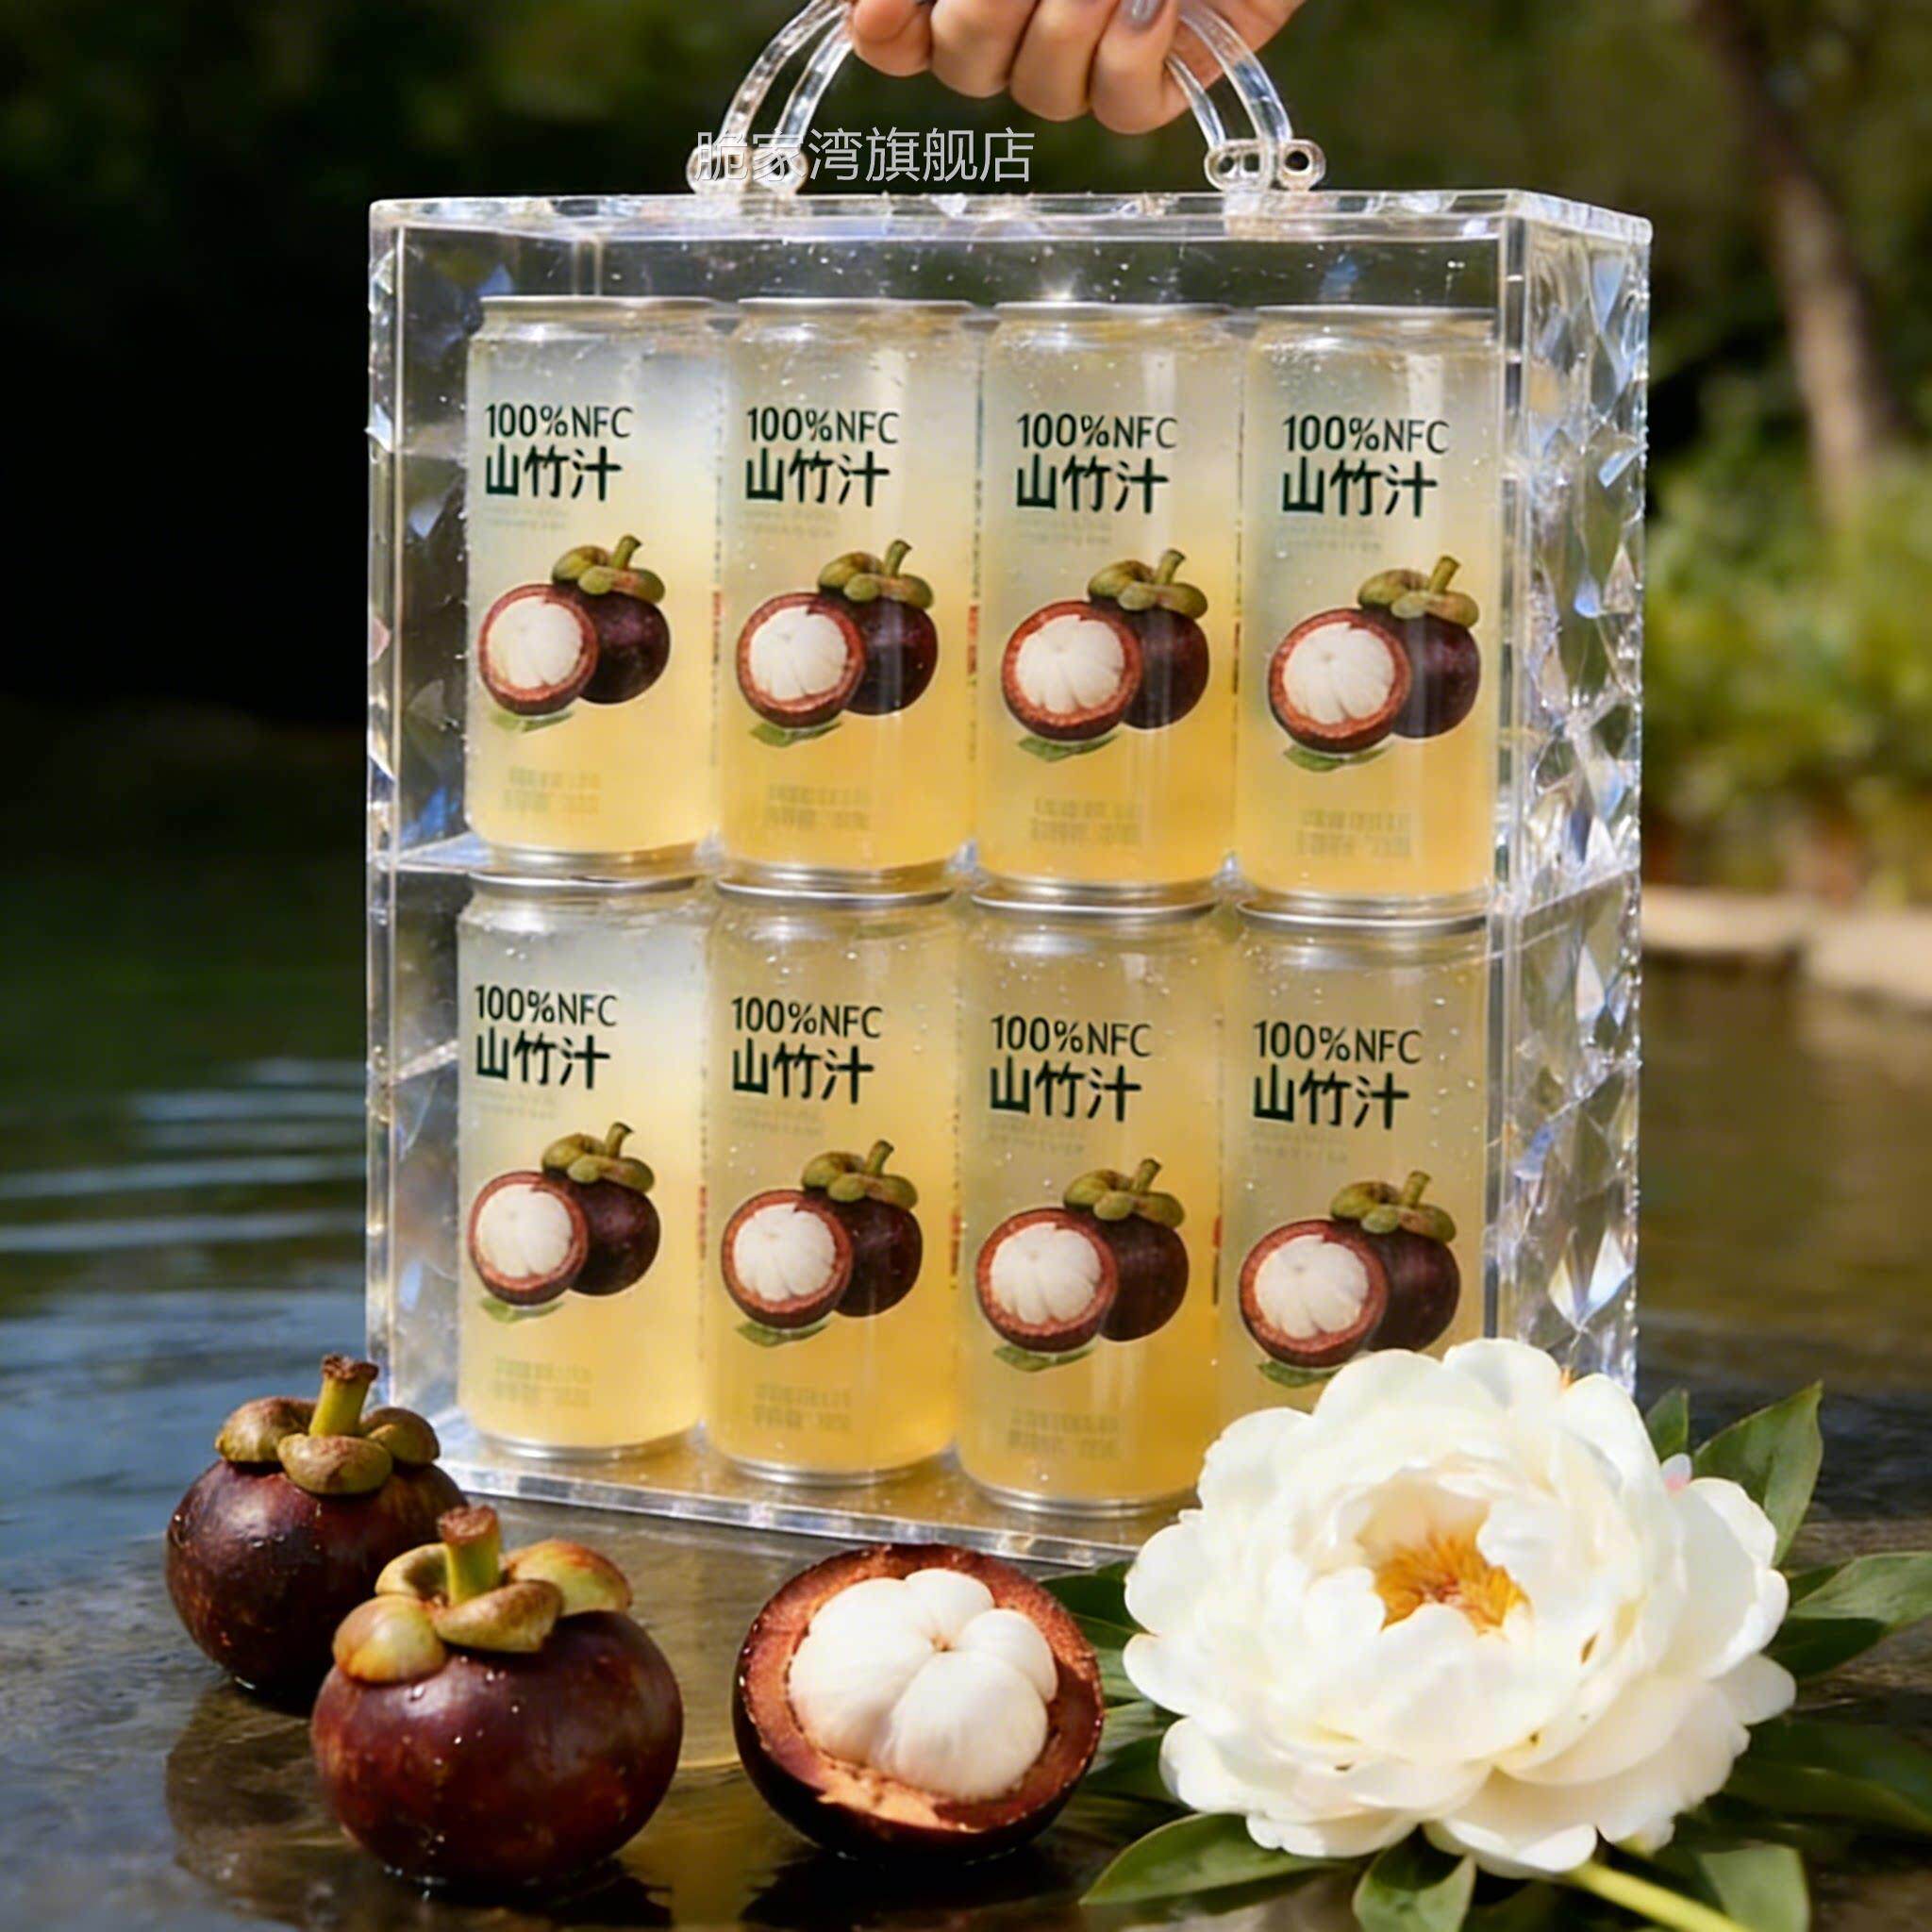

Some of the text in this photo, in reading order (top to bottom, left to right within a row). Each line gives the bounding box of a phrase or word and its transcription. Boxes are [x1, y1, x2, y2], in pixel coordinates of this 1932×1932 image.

[486, 403, 634, 439] 100%NFC
[748, 408, 900, 445] 100%NFC
[1017, 413, 1177, 449] 100%NFC
[1283, 415, 1450, 454] 100%NFC
[485, 444, 623, 501] 山竹汁
[745, 447, 890, 508] 山竹汁
[1016, 455, 1169, 514] 山竹汁
[1282, 457, 1439, 518] 山竹汁
[475, 984, 618, 1027] 100%NFC
[731, 997, 884, 1039] 100%NFC
[475, 1026, 610, 1090] 山竹汁
[991, 1015, 1152, 1058] 100%NFC
[1254, 1020, 1423, 1064] 100%NFC
[732, 1038, 874, 1104] 山竹汁
[990, 1057, 1141, 1122] 山竹汁
[1254, 1064, 1409, 1130] 山竹汁
